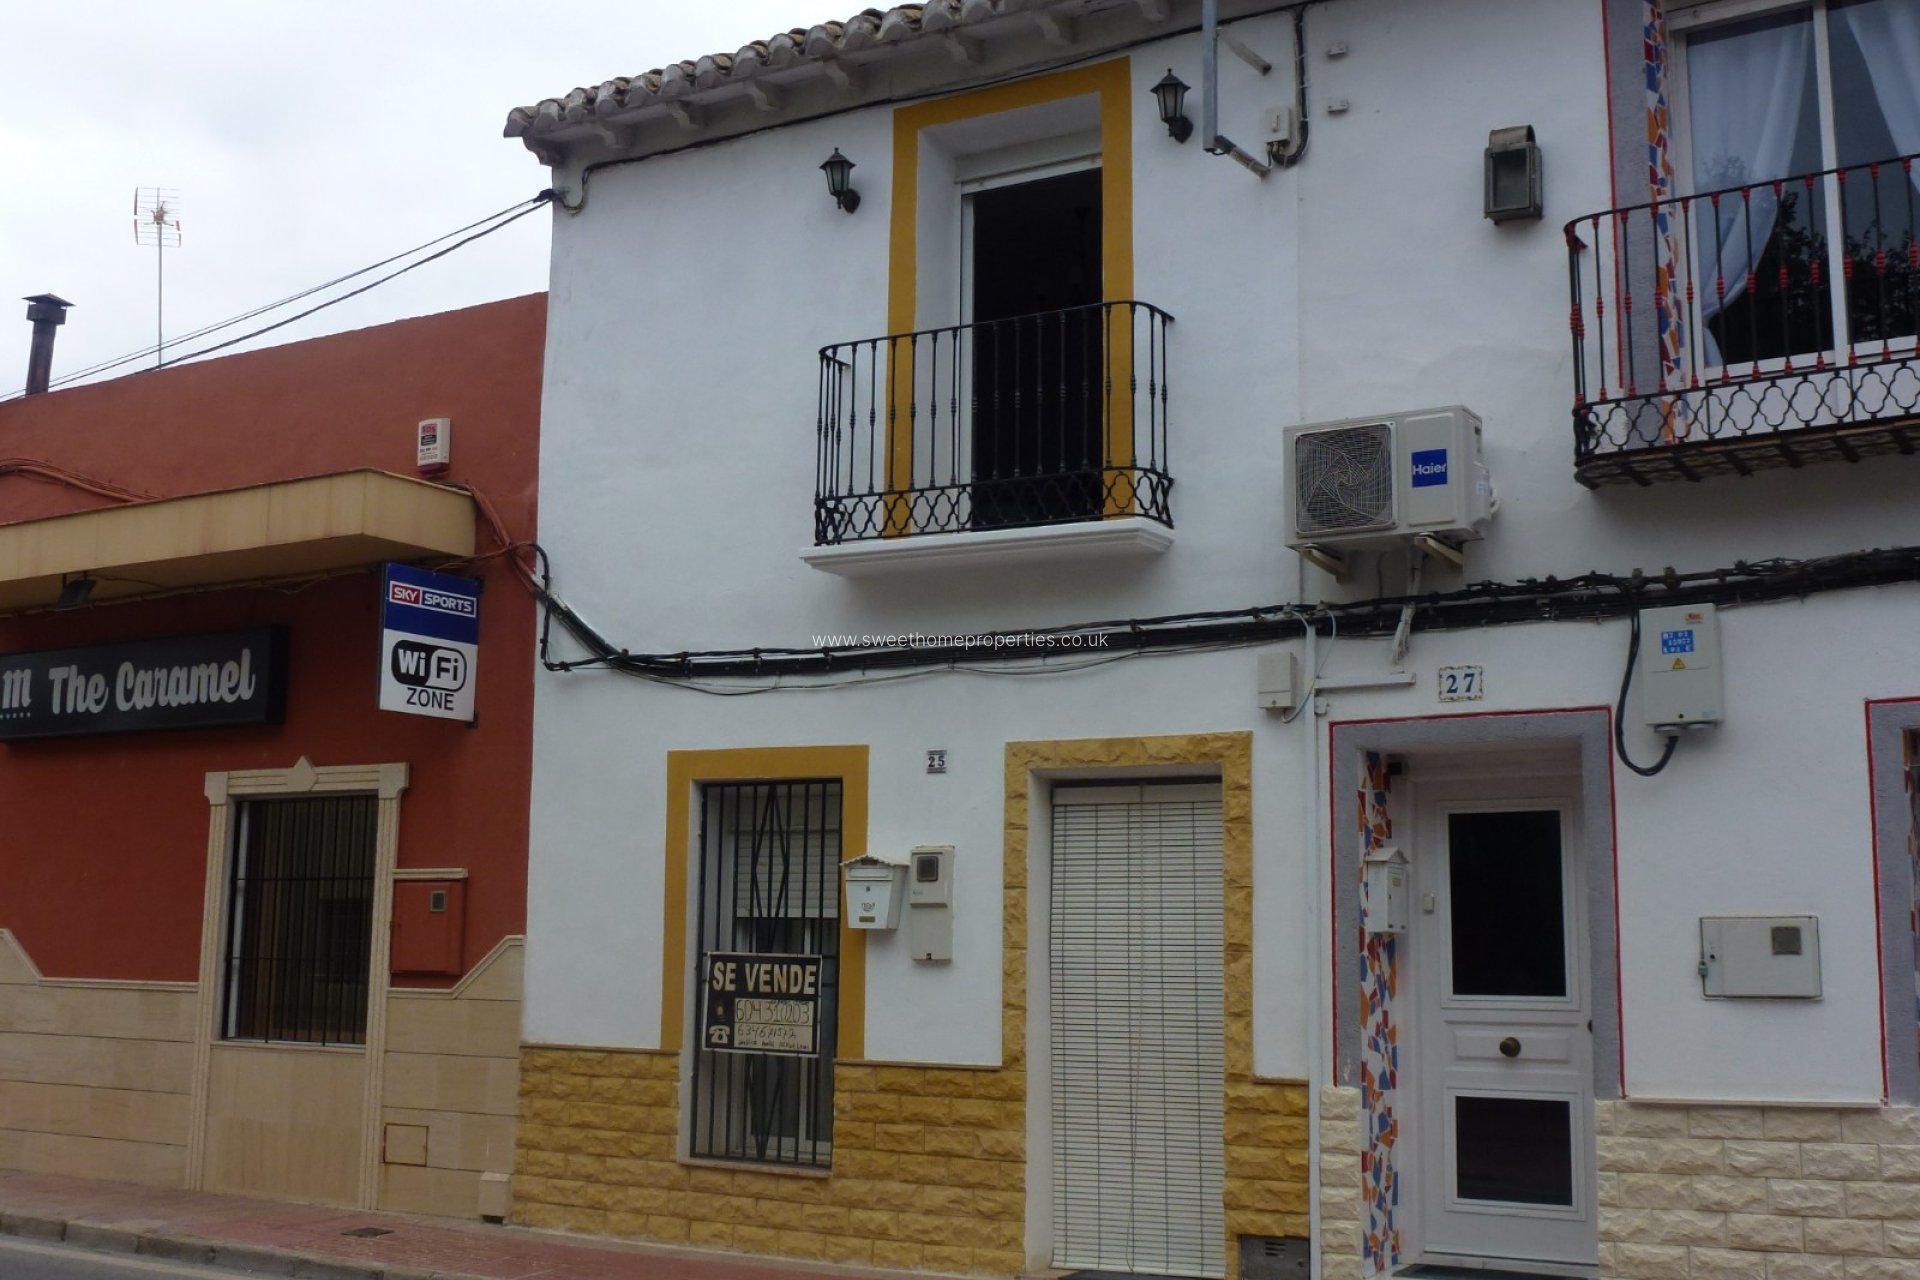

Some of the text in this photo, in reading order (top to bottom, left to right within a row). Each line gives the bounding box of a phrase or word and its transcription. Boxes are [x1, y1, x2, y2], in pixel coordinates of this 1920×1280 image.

[1412, 462, 1448, 476] Haier
[393, 587, 472, 612] SKY SPORTS
[48, 665, 109, 715] The
[115, 648, 256, 712] Caramel
[1445, 672, 1476, 694] 27
[406, 687, 455, 711] ZONE
[928, 755, 945, 768] 25
[712, 961, 817, 995] SE VENDE
